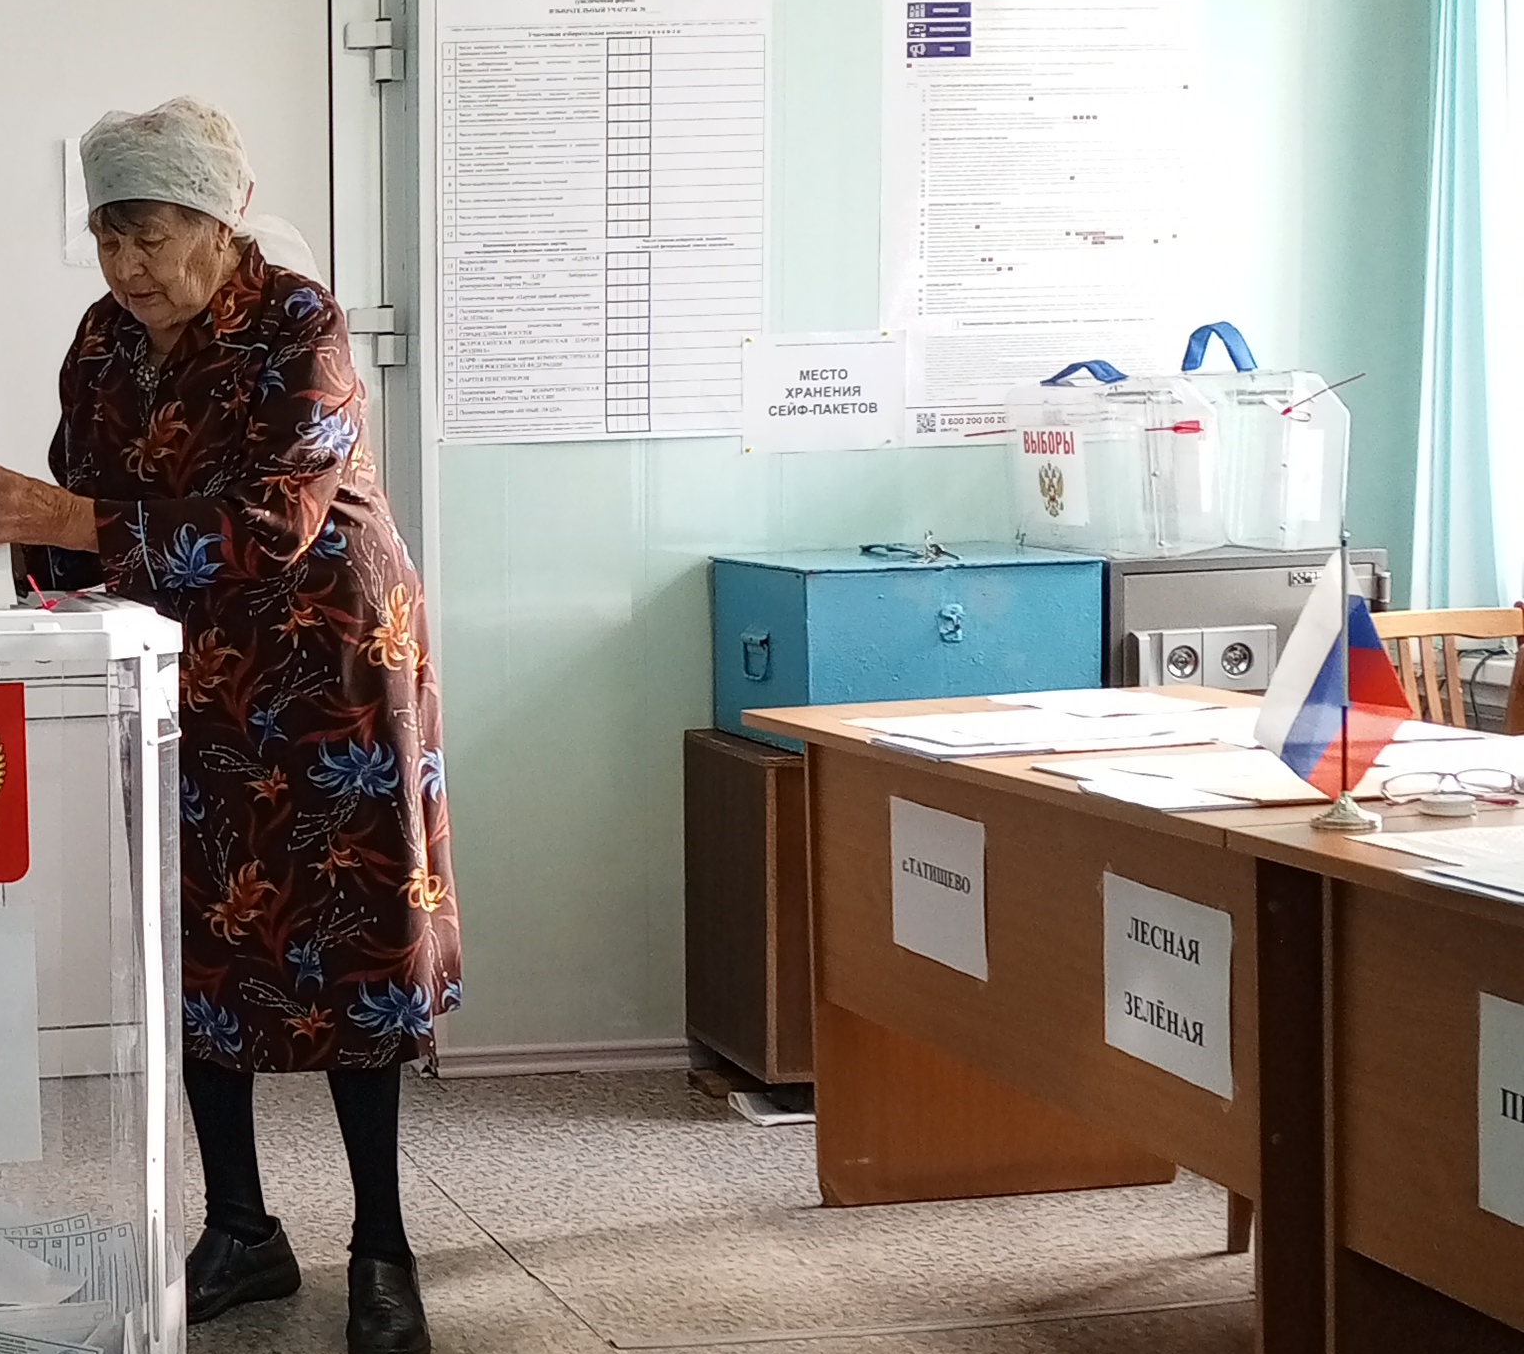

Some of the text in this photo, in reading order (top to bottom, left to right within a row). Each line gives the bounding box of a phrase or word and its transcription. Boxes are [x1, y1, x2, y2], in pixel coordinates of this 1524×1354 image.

[800, 368, 848, 382] МЕСТО
[786, 385, 862, 399] ХРАНЕНИЯ
[768, 401, 878, 417] СЕЙФ-ПАКЕТОВ
[966, 417, 982, 425] 200
[1023, 431, 1076, 455] ВЫБОРЫ
[902, 857, 972, 895] с.ТАТИЩЕВО
[1126, 916, 1200, 966] ЛЕСНАЯ
[1124, 990, 1204, 1048] ЗЕЛЁНАЯ
